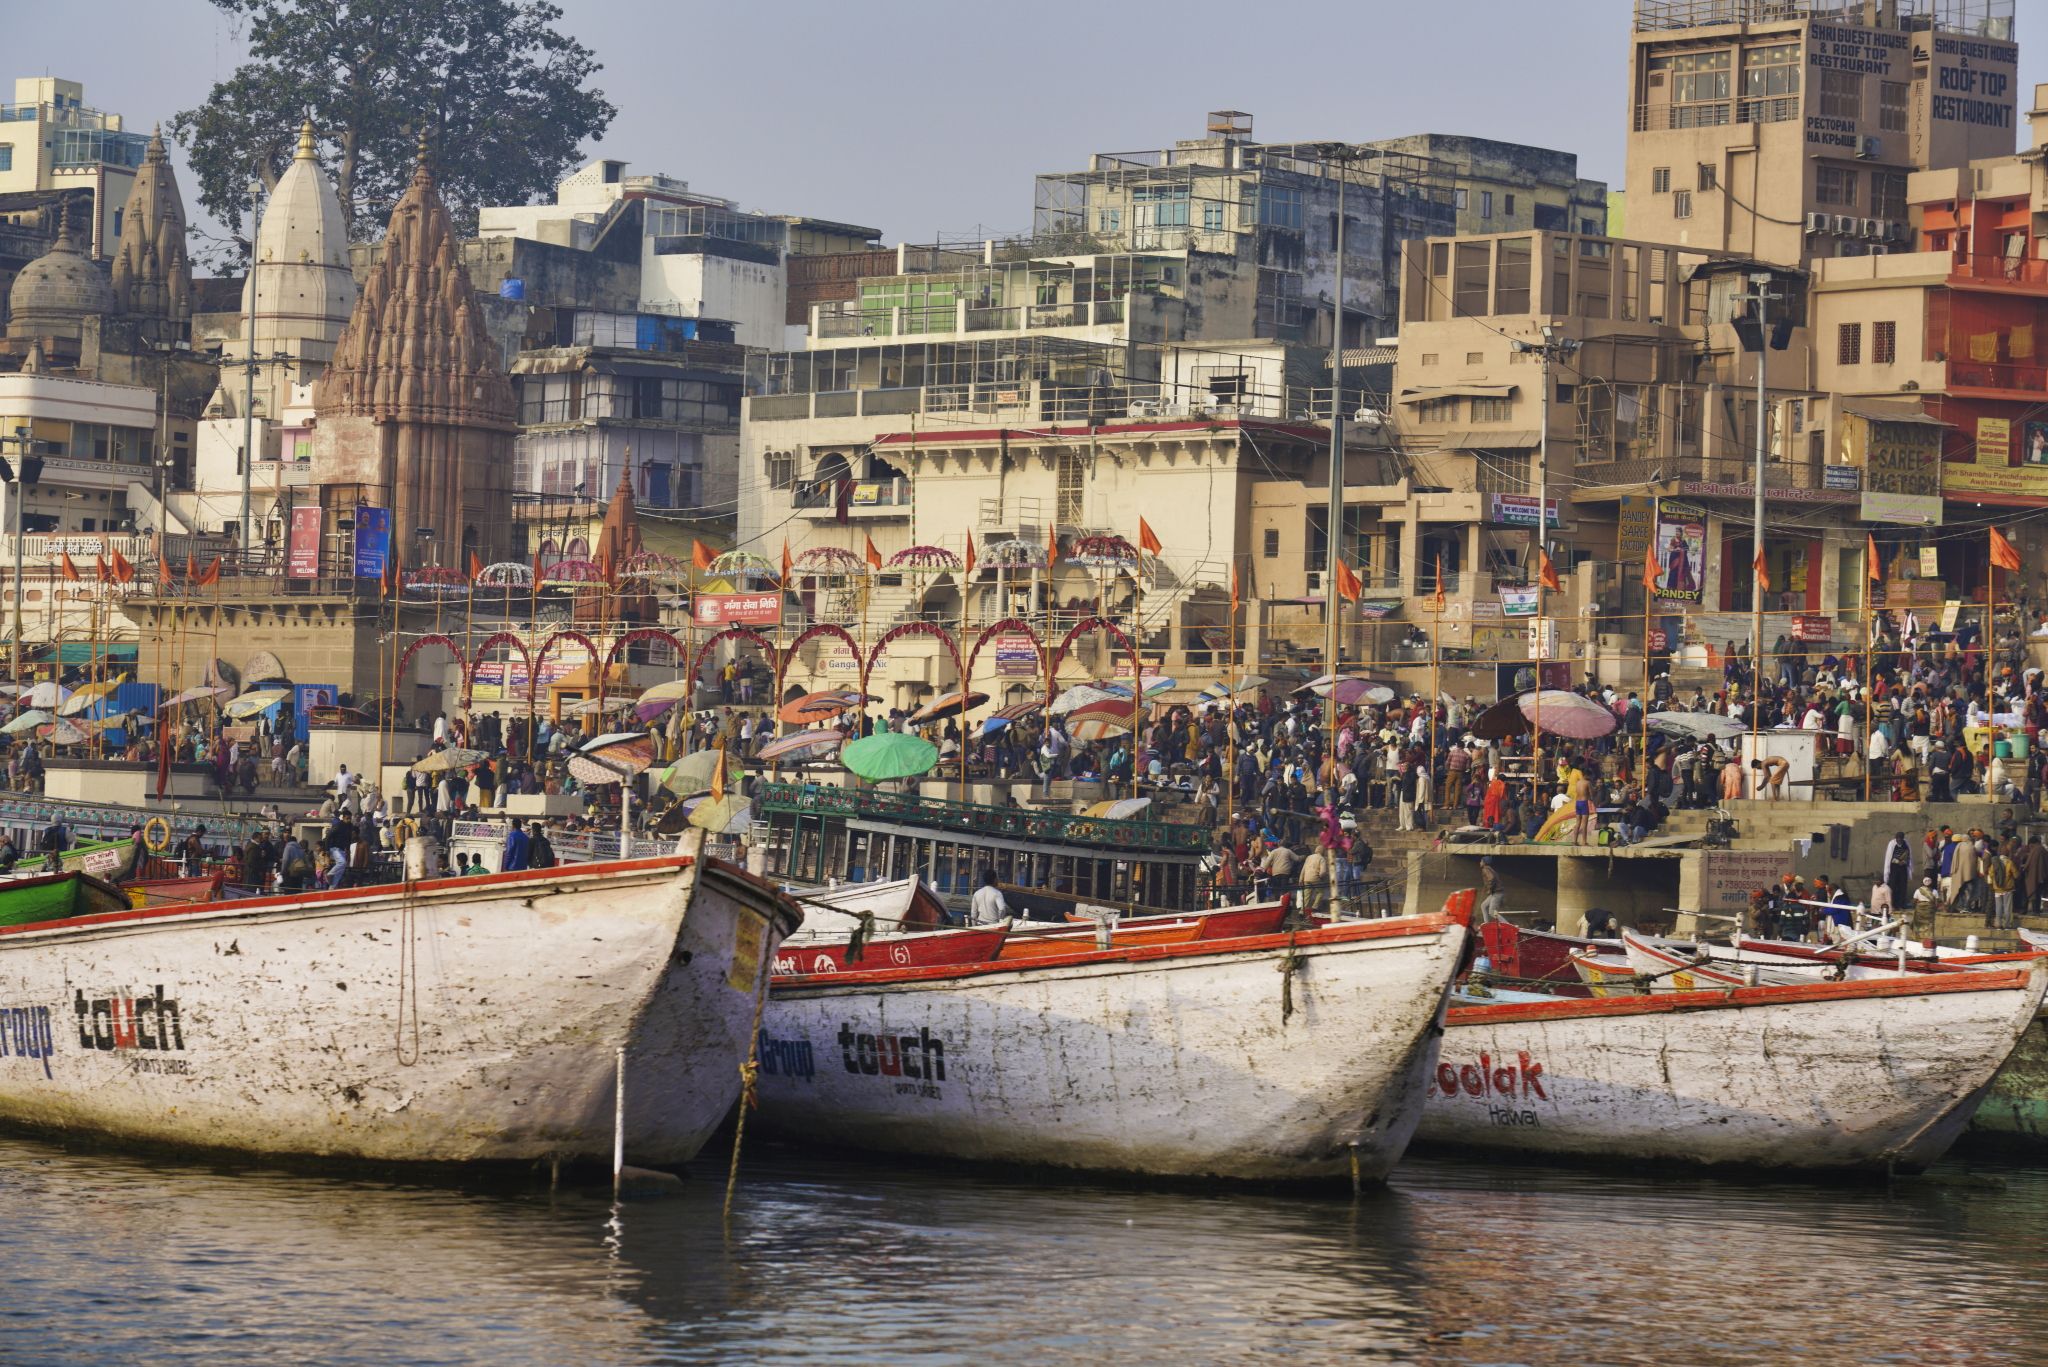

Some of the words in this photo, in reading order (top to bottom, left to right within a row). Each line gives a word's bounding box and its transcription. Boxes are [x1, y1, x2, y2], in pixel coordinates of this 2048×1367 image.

[1811, 24, 1836, 42] SHRI
[1837, 28, 1872, 45] GUEST
[1873, 32, 1908, 50] HOUSE
[1820, 42, 1827, 54] &
[1833, 43, 1862, 57] ROOF
[1864, 47, 1887, 60] TOP
[1935, 38, 1959, 55] SHRI
[1960, 41, 1989, 60] GUEST
[1990, 45, 2018, 64] HOUSE
[1810, 53, 1891, 75] RESTAURANT
[1960, 57, 1968, 68] &
[1940, 66, 1978, 92] ROOF
[1980, 71, 2007, 97] TOP
[1933, 94, 2013, 128] RESTAURANT
[1807, 117, 1855, 133] РЕСТОРАН
[1807, 131, 1820, 143] НА
[1879, 448, 1924, 470] SAREE
[1621, 525, 1649, 538] SAREE
[724, 599, 741, 609] गंगा
[743, 598, 758, 609] सेवा
[759, 597, 777, 609] निधि
[1655, 588, 1700, 600] PANDEY
[829, 660, 855, 669] Ganga
[1721, 889, 1748, 903] नमामि
[74, 984, 185, 1051] touch
[758, 1027, 815, 1083] Group
[837, 1022, 946, 1082] touch
[1427, 1050, 1548, 1101] oolak
